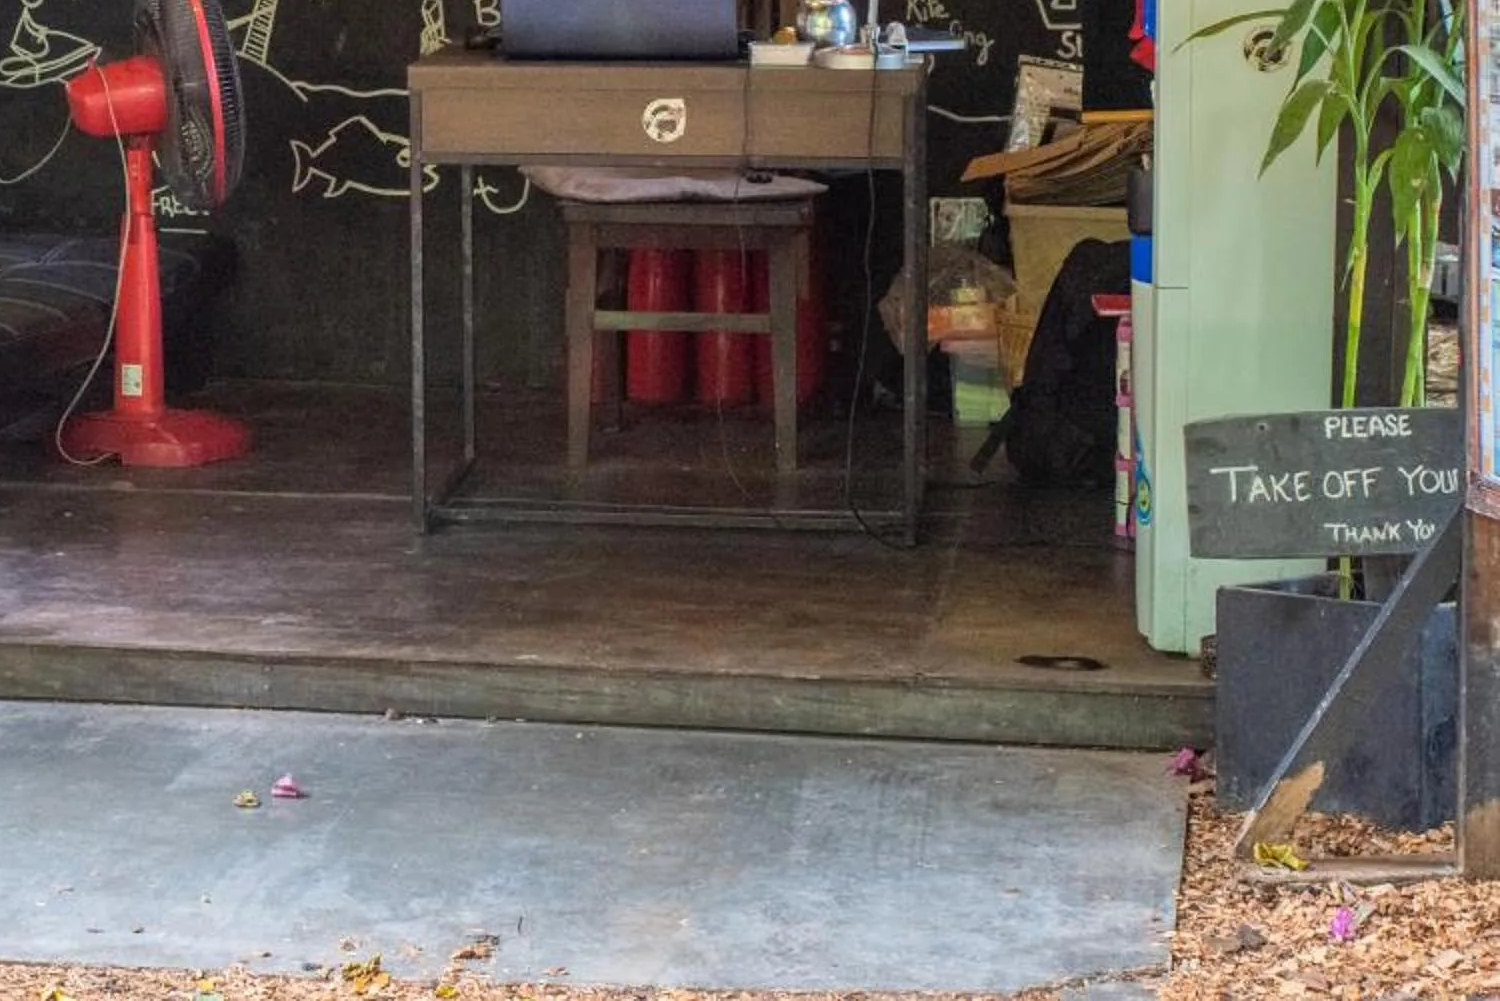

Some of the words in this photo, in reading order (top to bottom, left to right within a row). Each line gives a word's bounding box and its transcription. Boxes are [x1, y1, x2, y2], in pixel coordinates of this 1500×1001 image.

[1324, 414, 1412, 439] PLEASE
[1209, 465, 1311, 504] TAKE
[1323, 466, 1382, 499] OFF
[1324, 521, 1401, 544] THANK
[1406, 519, 1435, 541] YO
